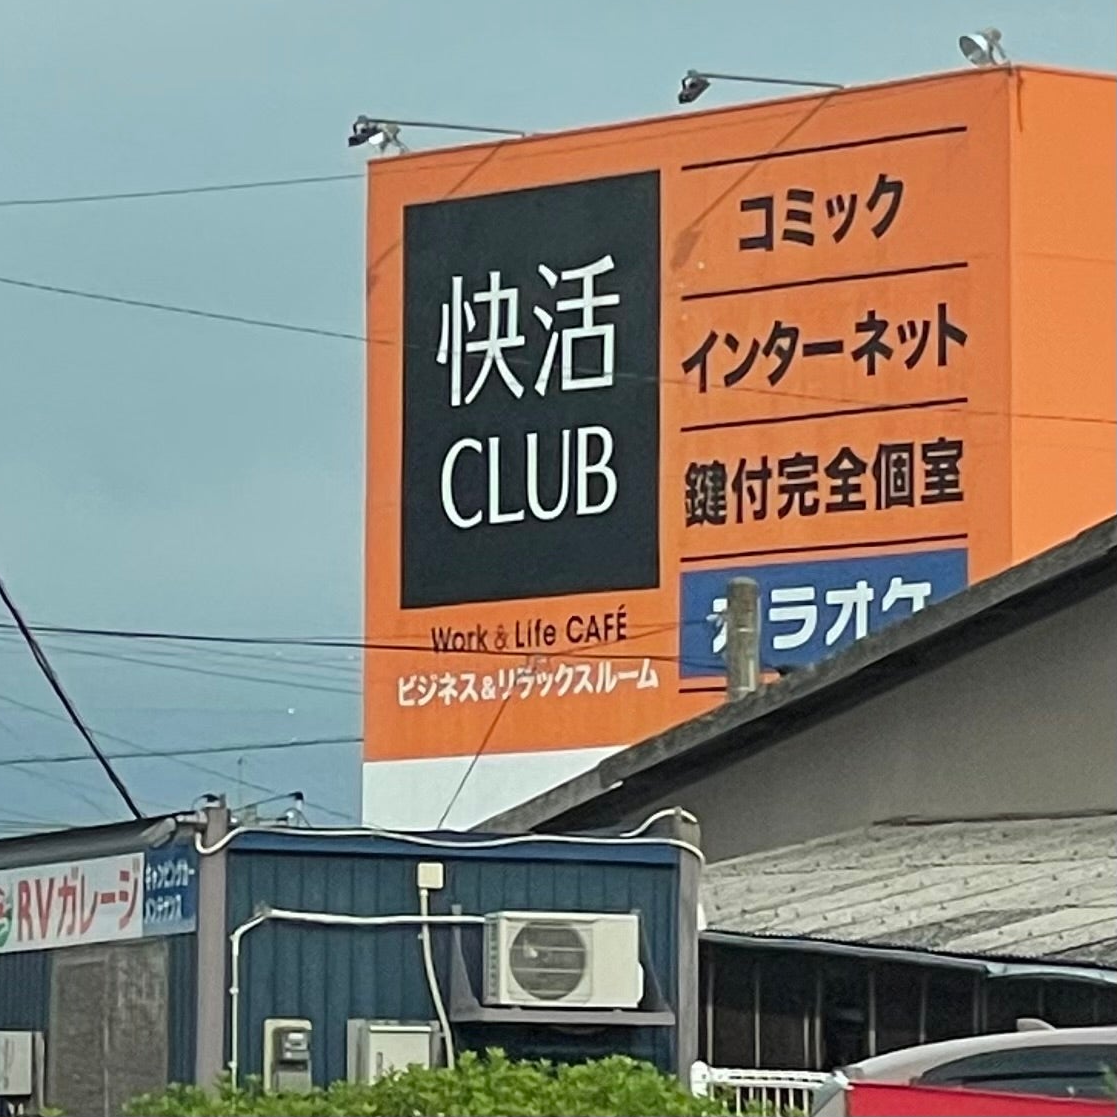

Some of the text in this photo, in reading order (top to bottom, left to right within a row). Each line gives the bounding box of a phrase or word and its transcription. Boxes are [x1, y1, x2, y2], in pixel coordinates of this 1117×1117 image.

[739, 173, 904, 252] コミック
[435, 254, 621, 406] 快活
[681, 302, 968, 393] インターネット
[439, 425, 618, 529] CLUB
[684, 437, 964, 528] 鍵付完全個室
[431, 604, 628, 653] Work & Life CAFÉ
[713, 576, 932, 654] ラオケ
[17, 858, 141, 942] RVガレージ
